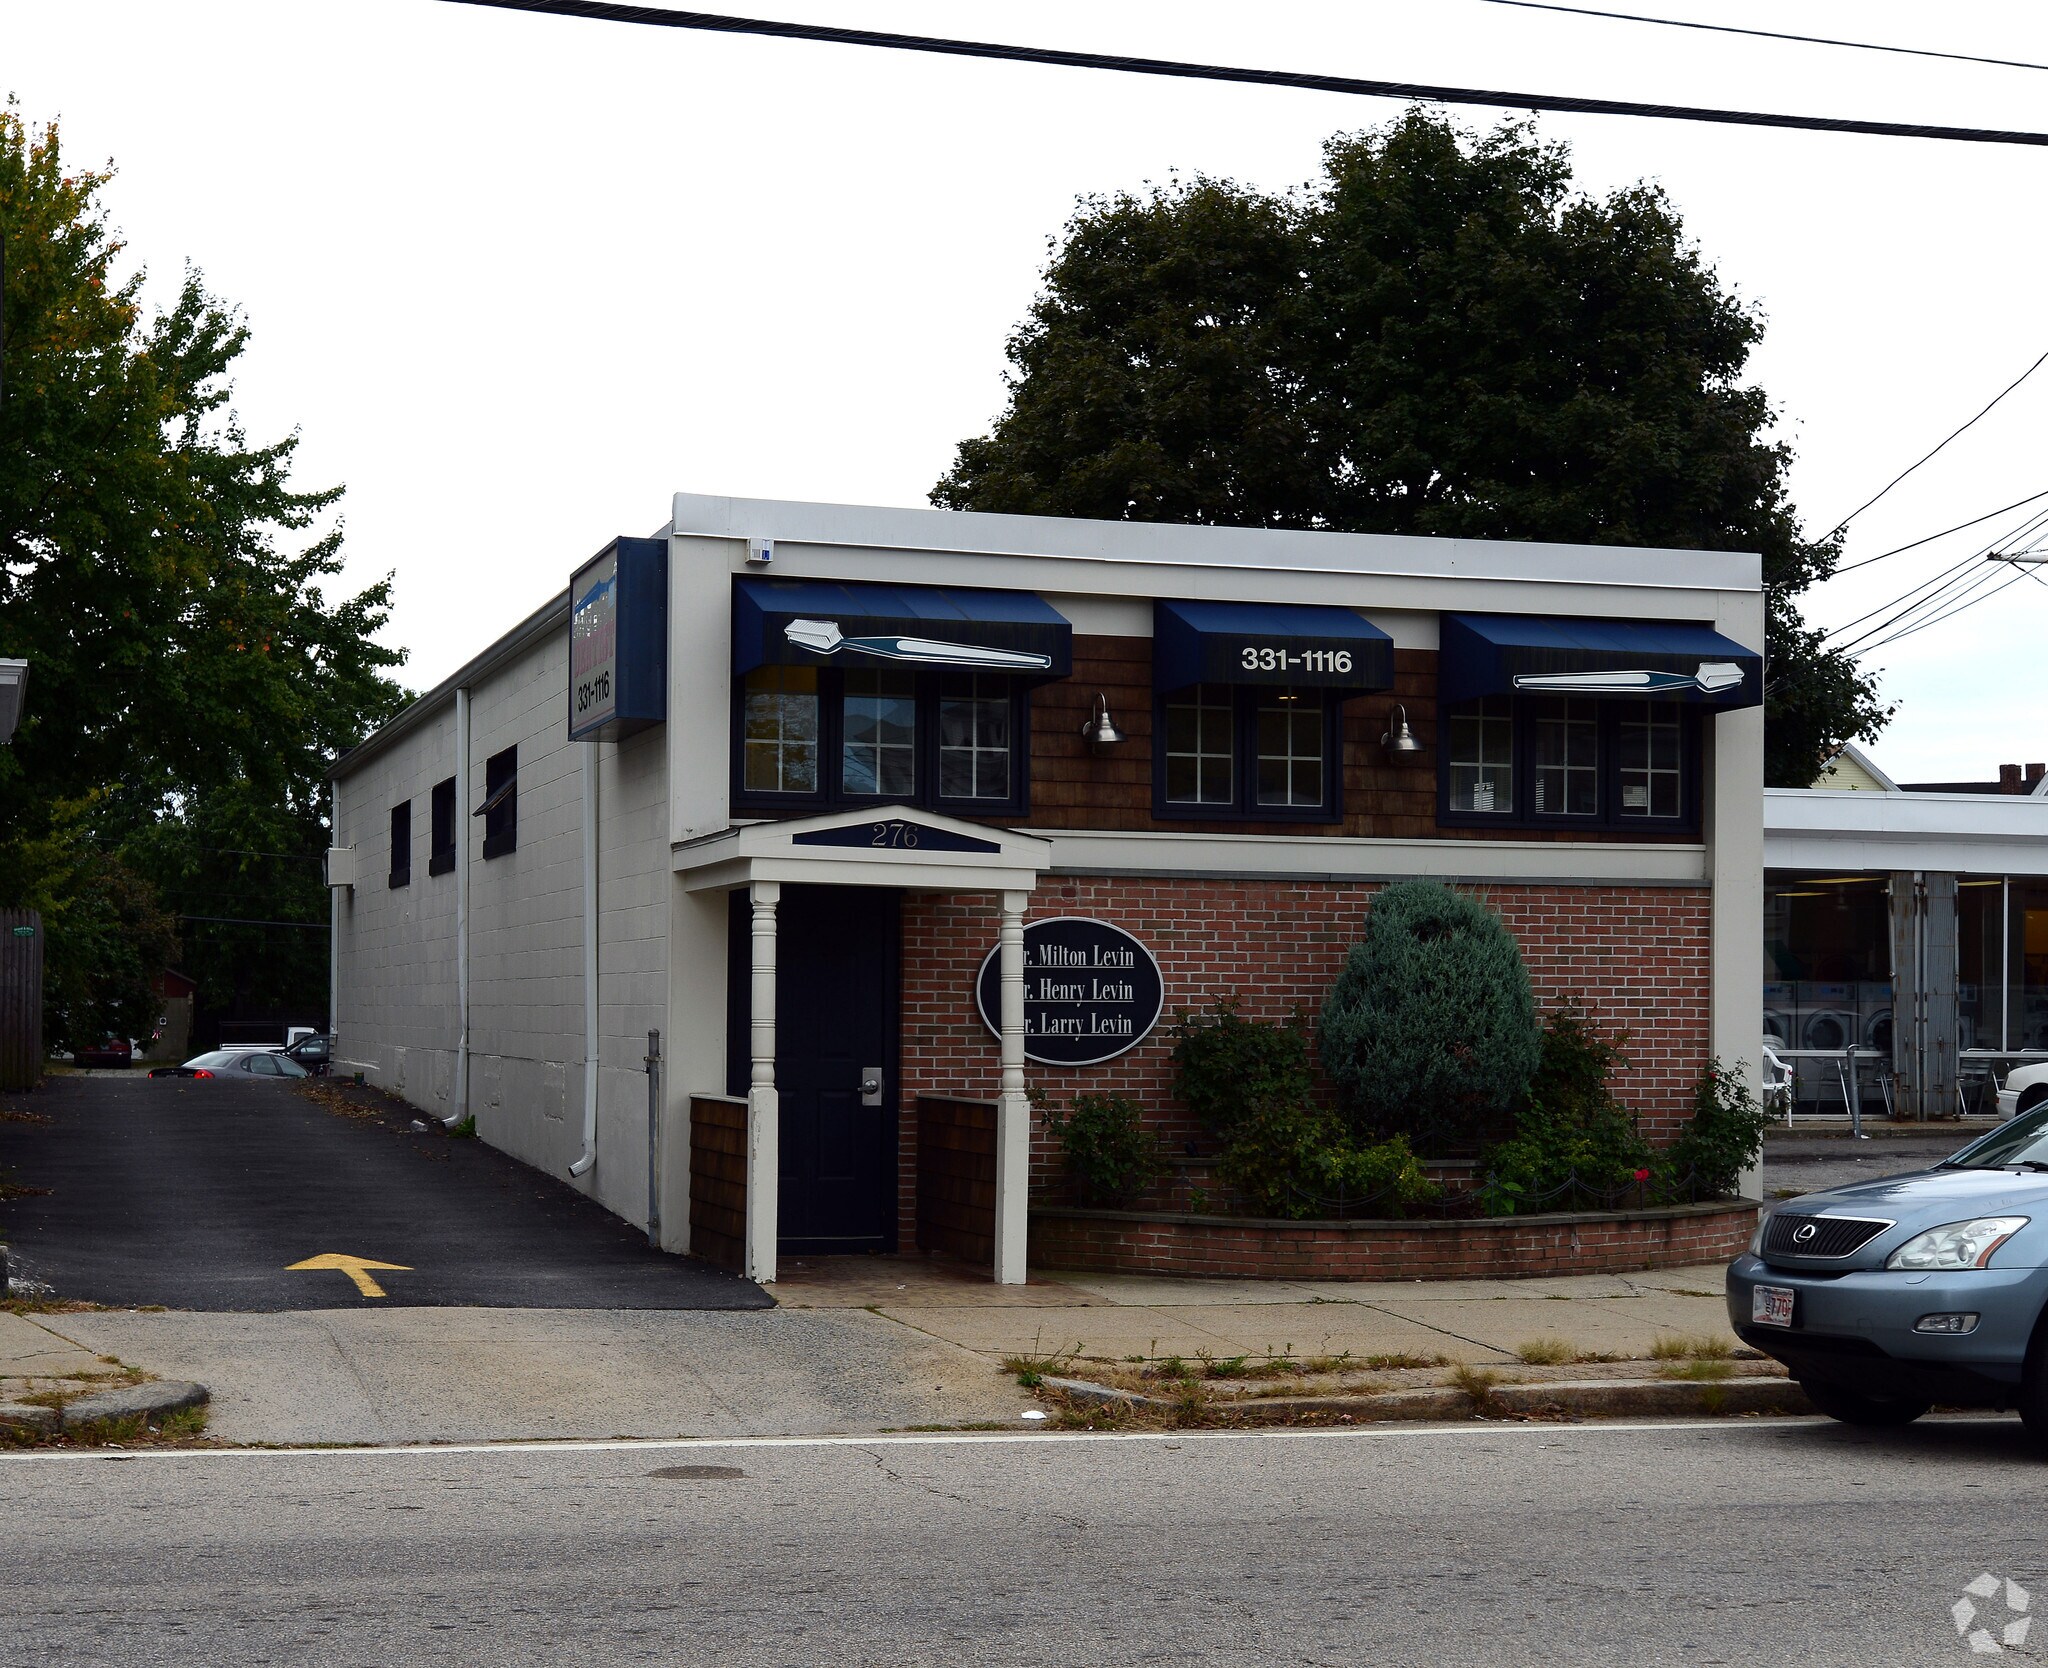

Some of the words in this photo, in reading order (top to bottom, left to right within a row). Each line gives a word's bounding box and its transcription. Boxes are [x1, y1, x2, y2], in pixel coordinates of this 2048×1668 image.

[1241, 647, 1353, 673] 331-1116
[578, 670, 610, 711] 331-1116
[871, 823, 918, 848] 276
[1039, 944, 1087, 966] Milton
[1093, 944, 1135, 967] Levin
[1040, 978, 1086, 1007] Henry
[1092, 978, 1133, 1000] Levin
[1040, 1012, 1084, 1041] Larry
[1091, 1012, 1133, 1034] Levin
